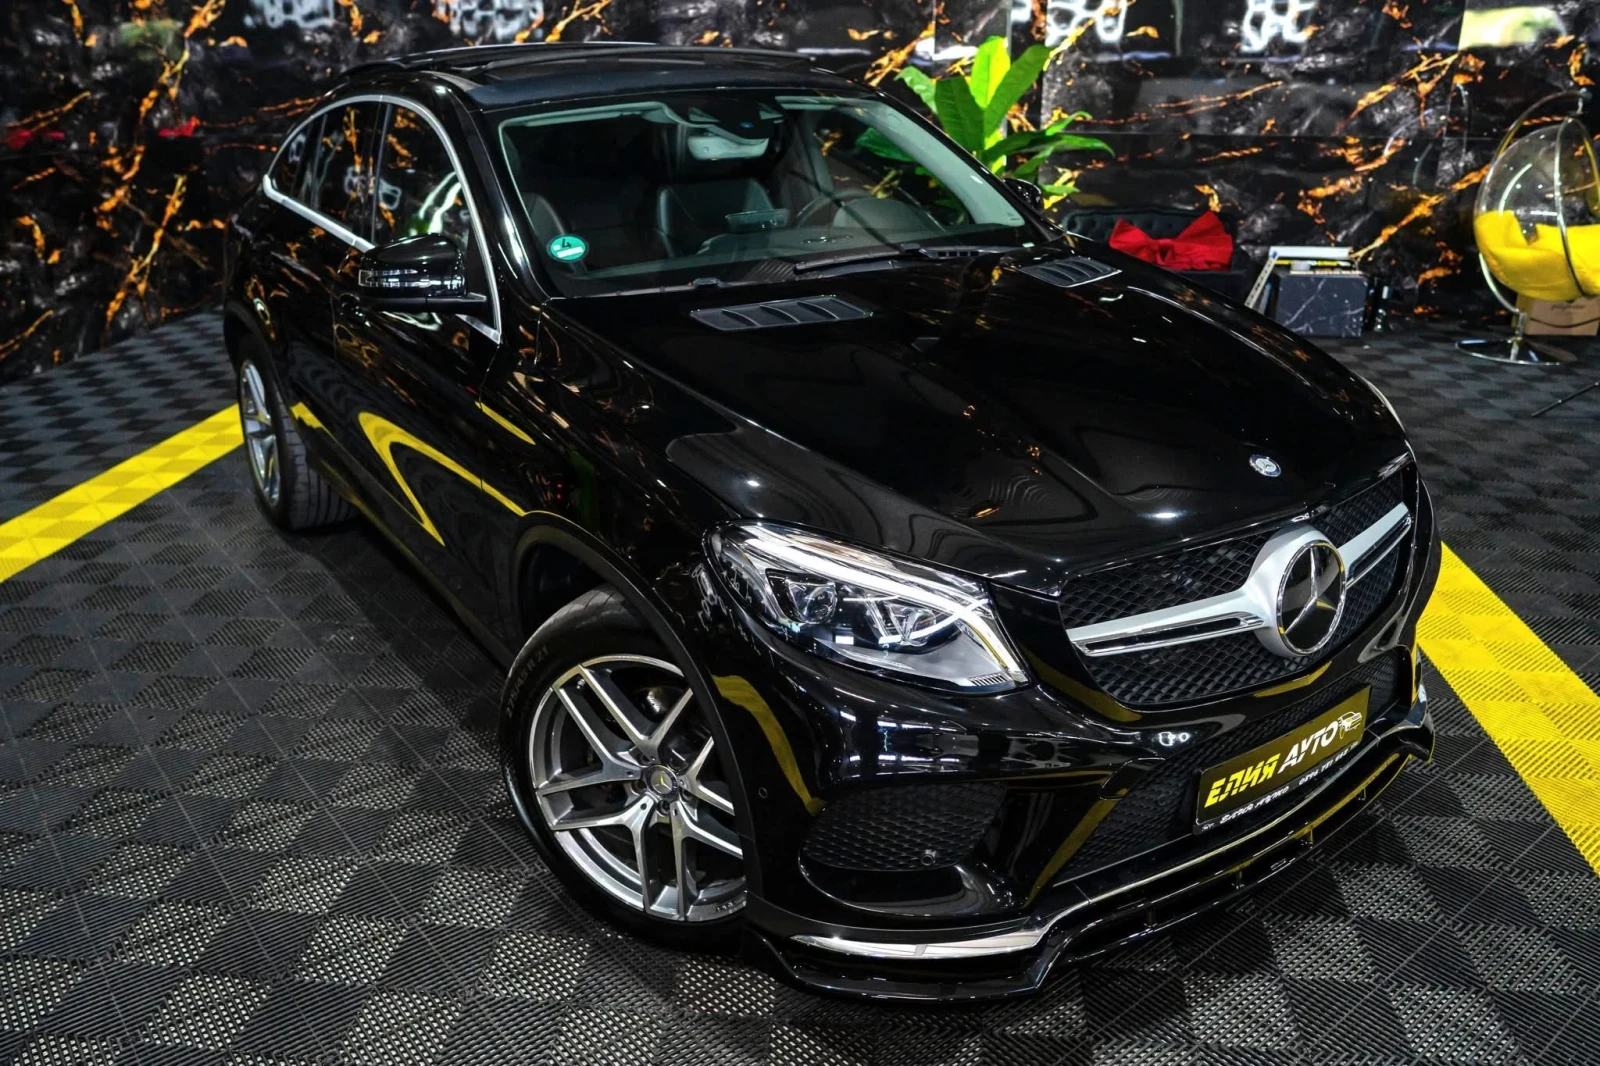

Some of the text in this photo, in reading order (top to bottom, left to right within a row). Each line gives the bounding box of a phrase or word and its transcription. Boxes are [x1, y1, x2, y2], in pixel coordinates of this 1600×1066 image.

[562, 237, 572, 249] 4
[1204, 720, 1339, 808] ЕЛИЯ АУТО
